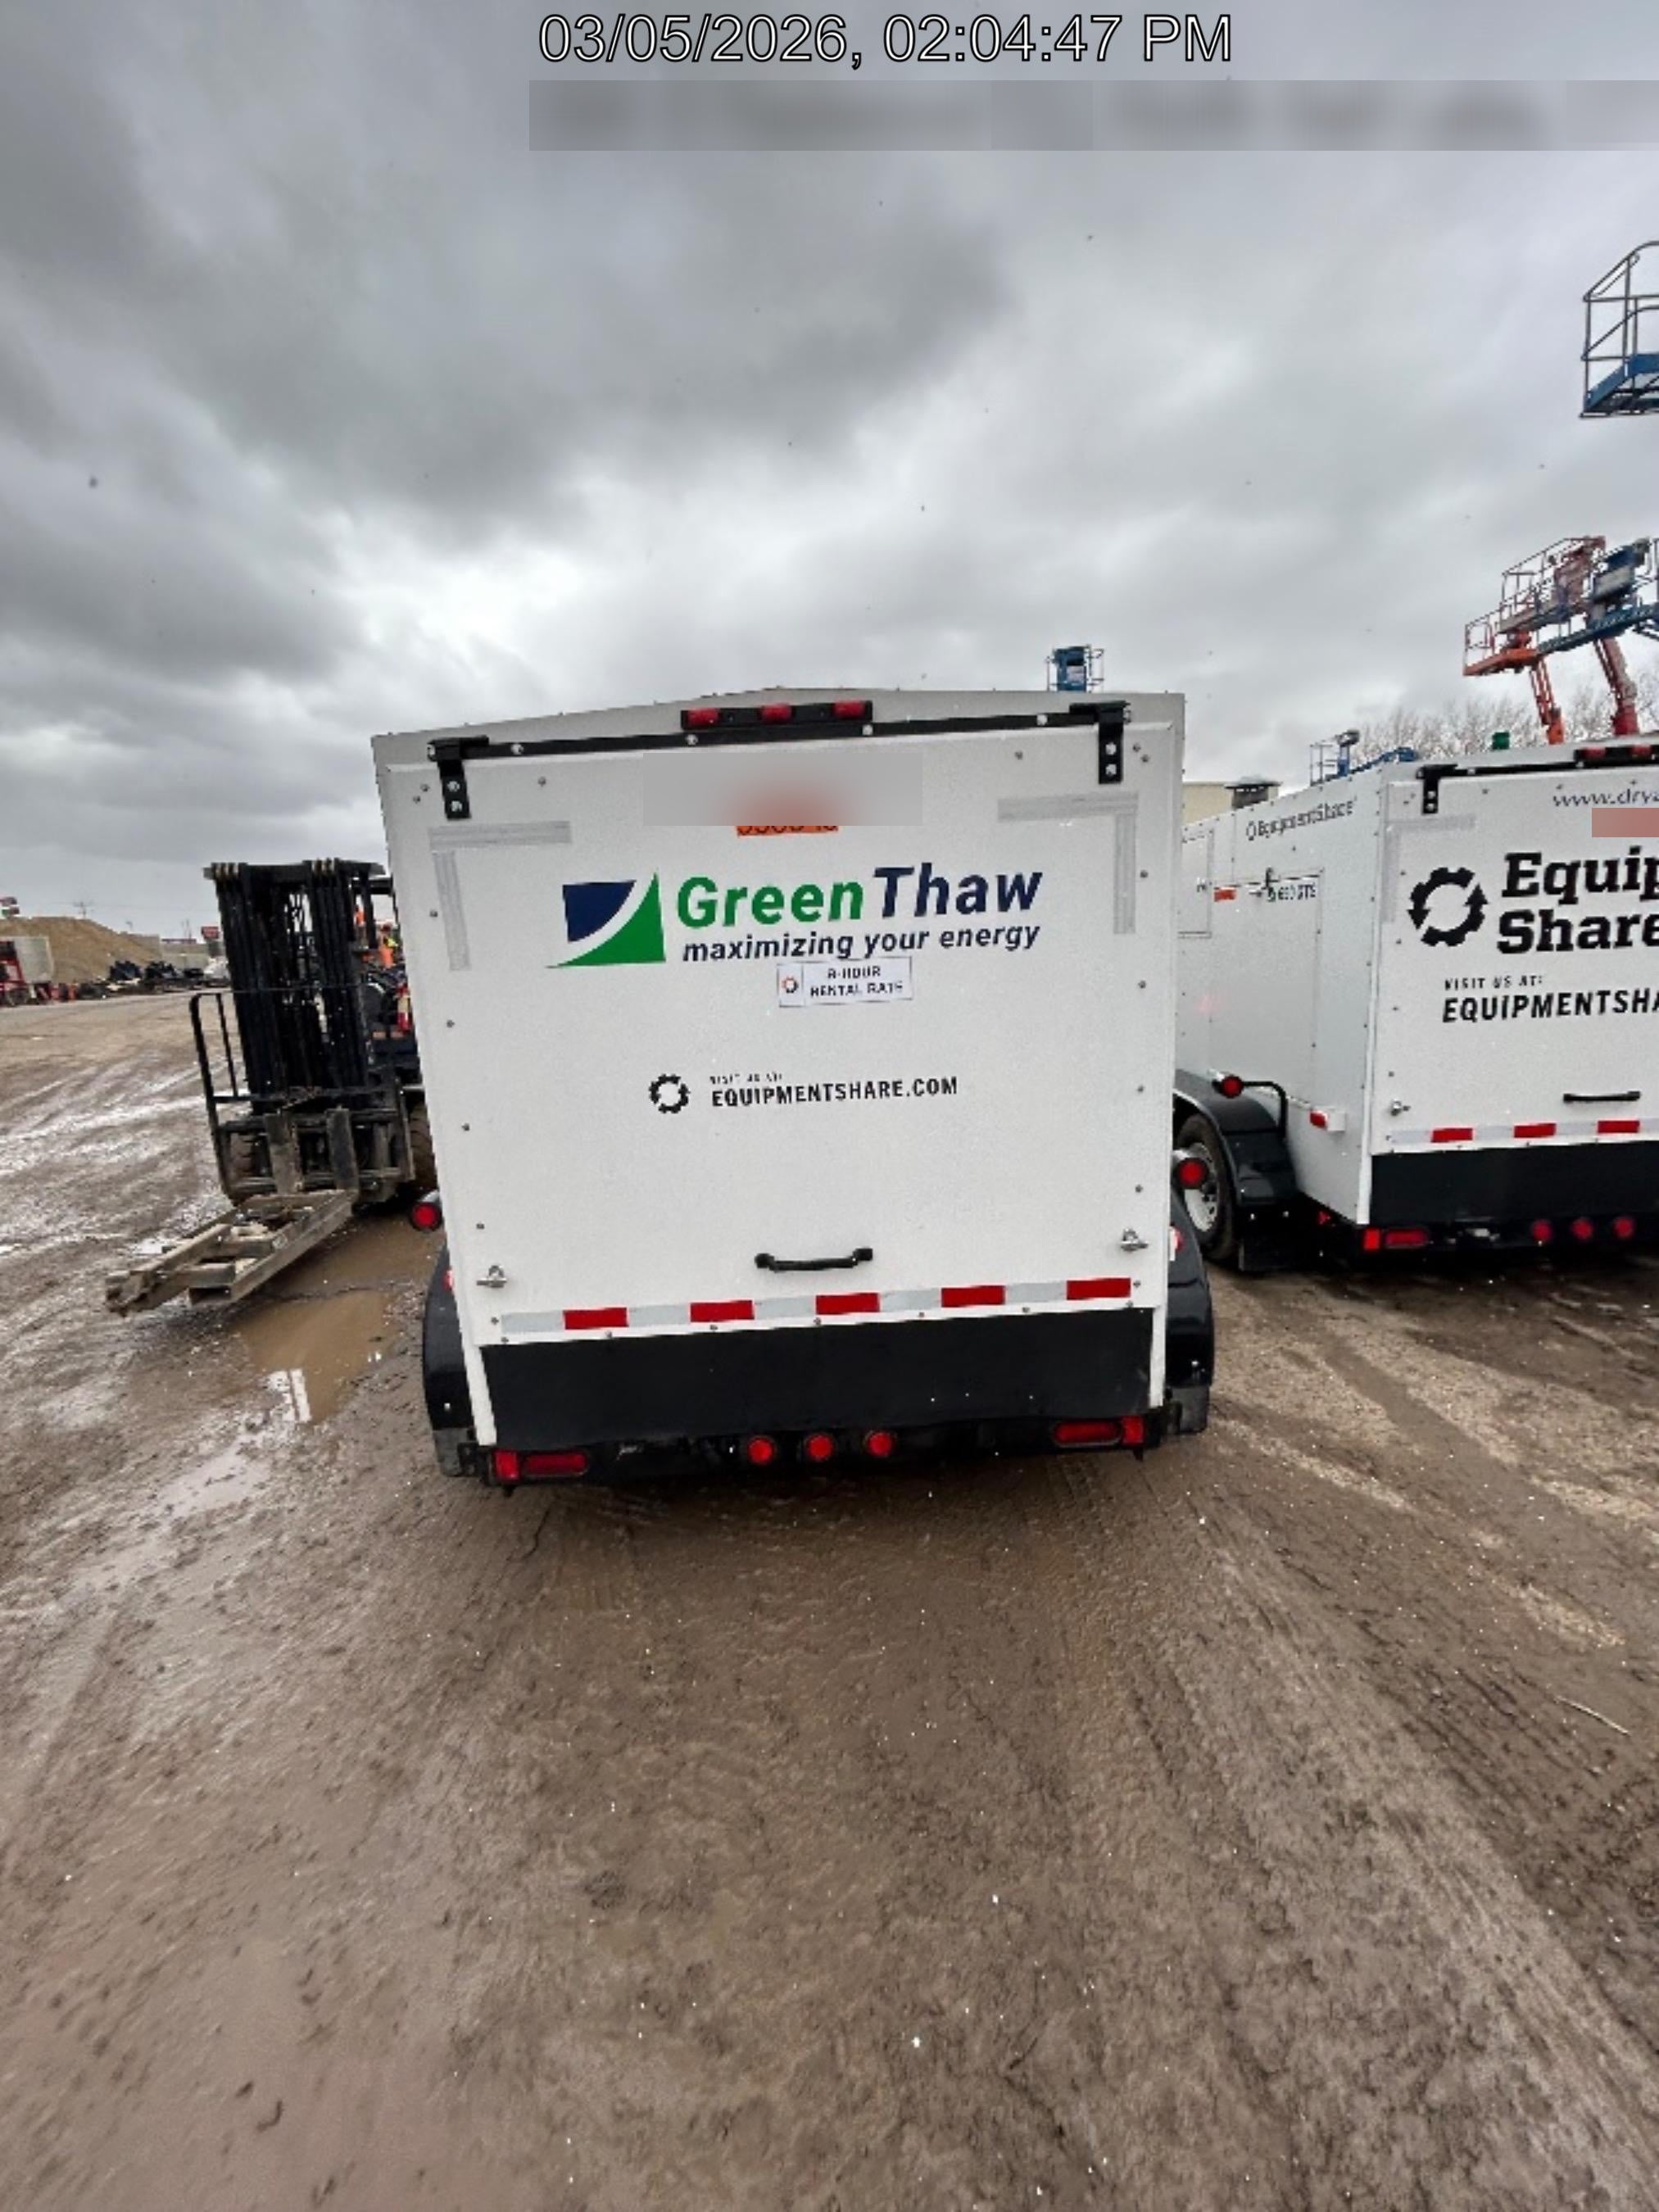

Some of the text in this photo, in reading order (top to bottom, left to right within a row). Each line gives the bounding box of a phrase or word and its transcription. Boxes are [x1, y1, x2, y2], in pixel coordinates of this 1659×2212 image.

[682, 925, 1041, 961] maximizing your energy
[1444, 977, 1485, 990] VISIT
[1494, 975, 1512, 989] US
[711, 1076, 958, 1108] EQUIPMENTSHARE.COM
